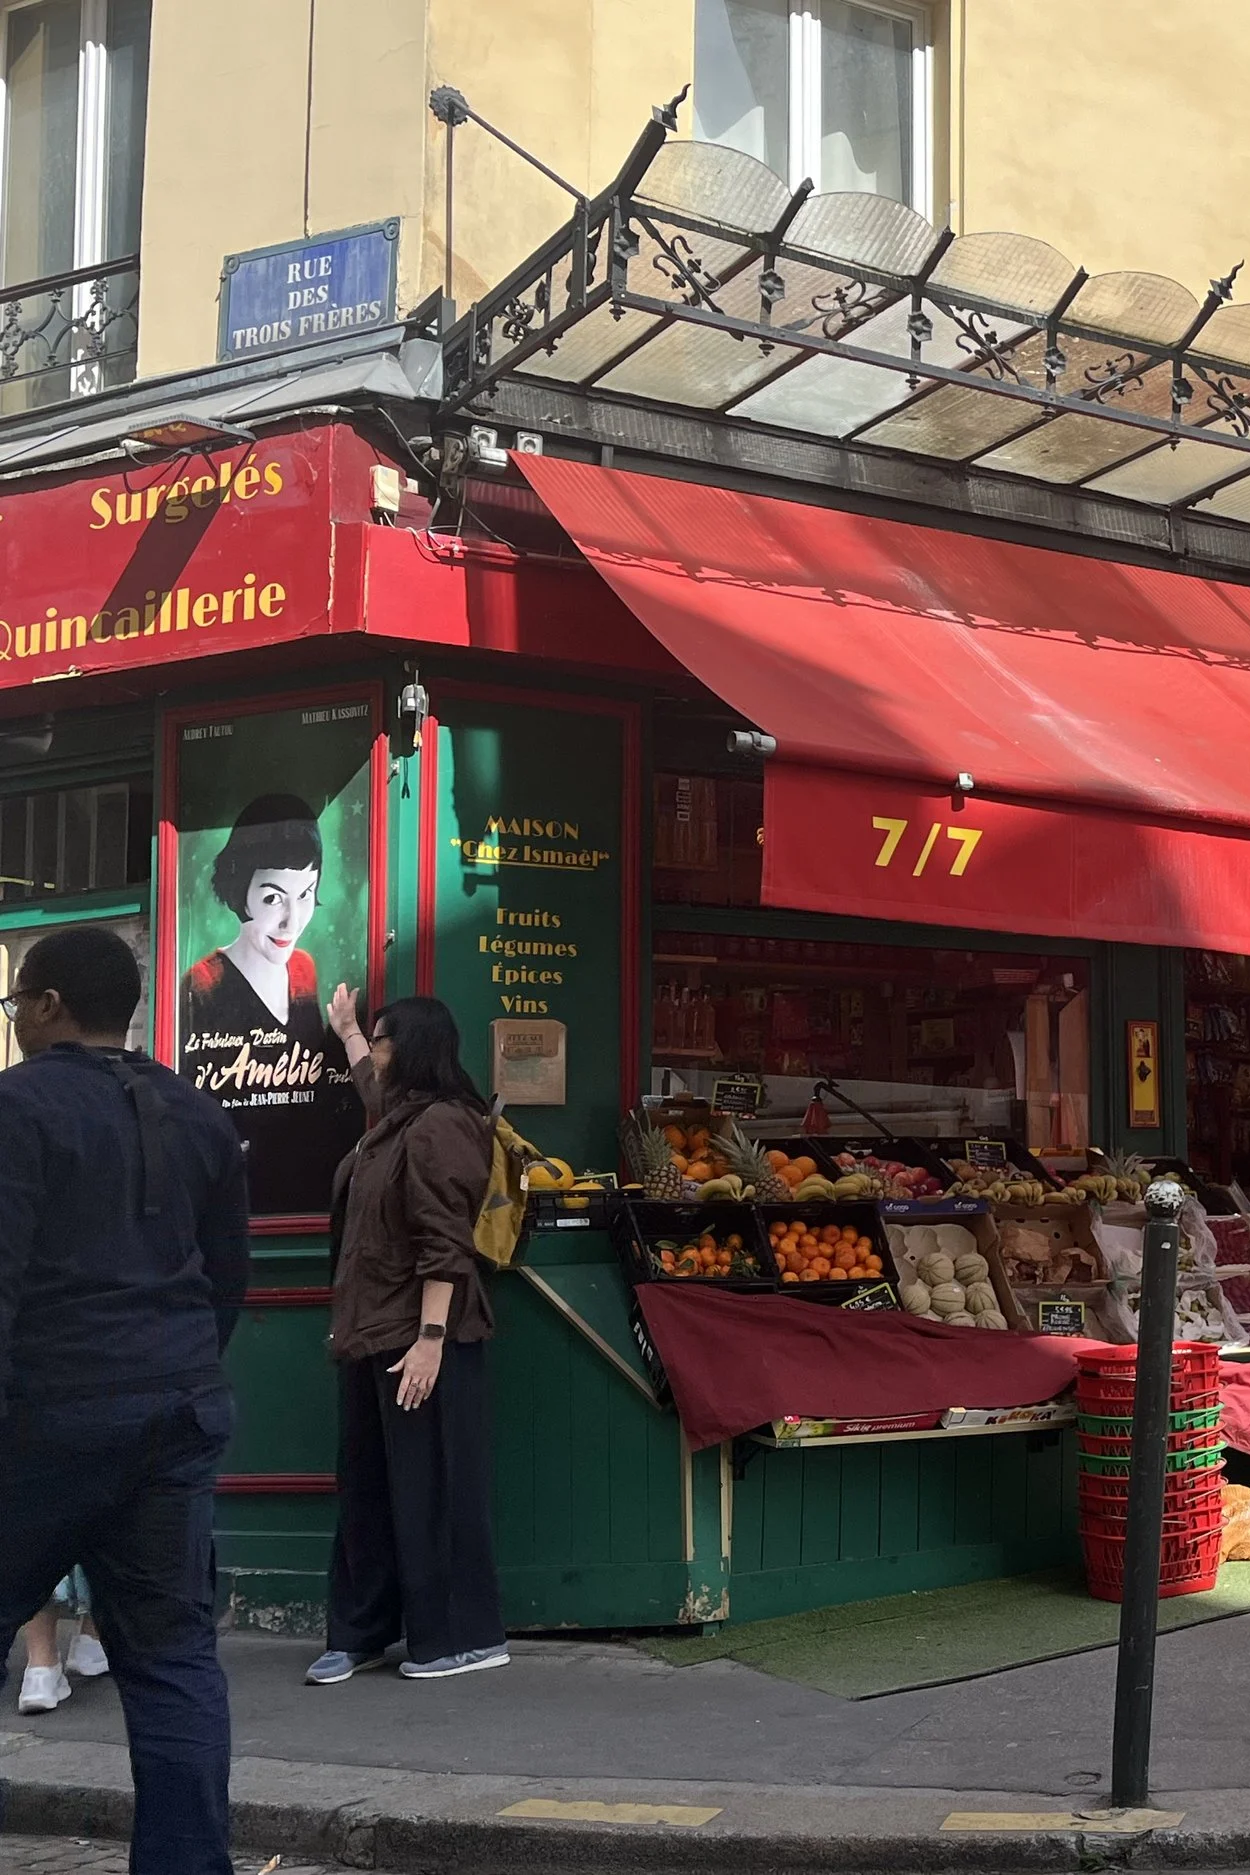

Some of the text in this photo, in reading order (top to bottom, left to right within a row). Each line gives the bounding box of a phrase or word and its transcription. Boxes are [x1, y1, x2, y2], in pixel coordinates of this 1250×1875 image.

[287, 256, 332, 284] RUE
[287, 284, 329, 311] DES
[232, 301, 382, 350] TROIS FRÈRES
[89, 452, 284, 530] Surgelés
[484, 815, 579, 840] MAISON
[872, 816, 984, 877] 7/7
[496, 907, 562, 929] Fruits
[479, 934, 578, 958] Légumes
[491, 961, 563, 986] Épices
[500, 995, 549, 1014] Vins
[250, 1027, 287, 1046] Destin
[870, 1420, 916, 1433] premium
